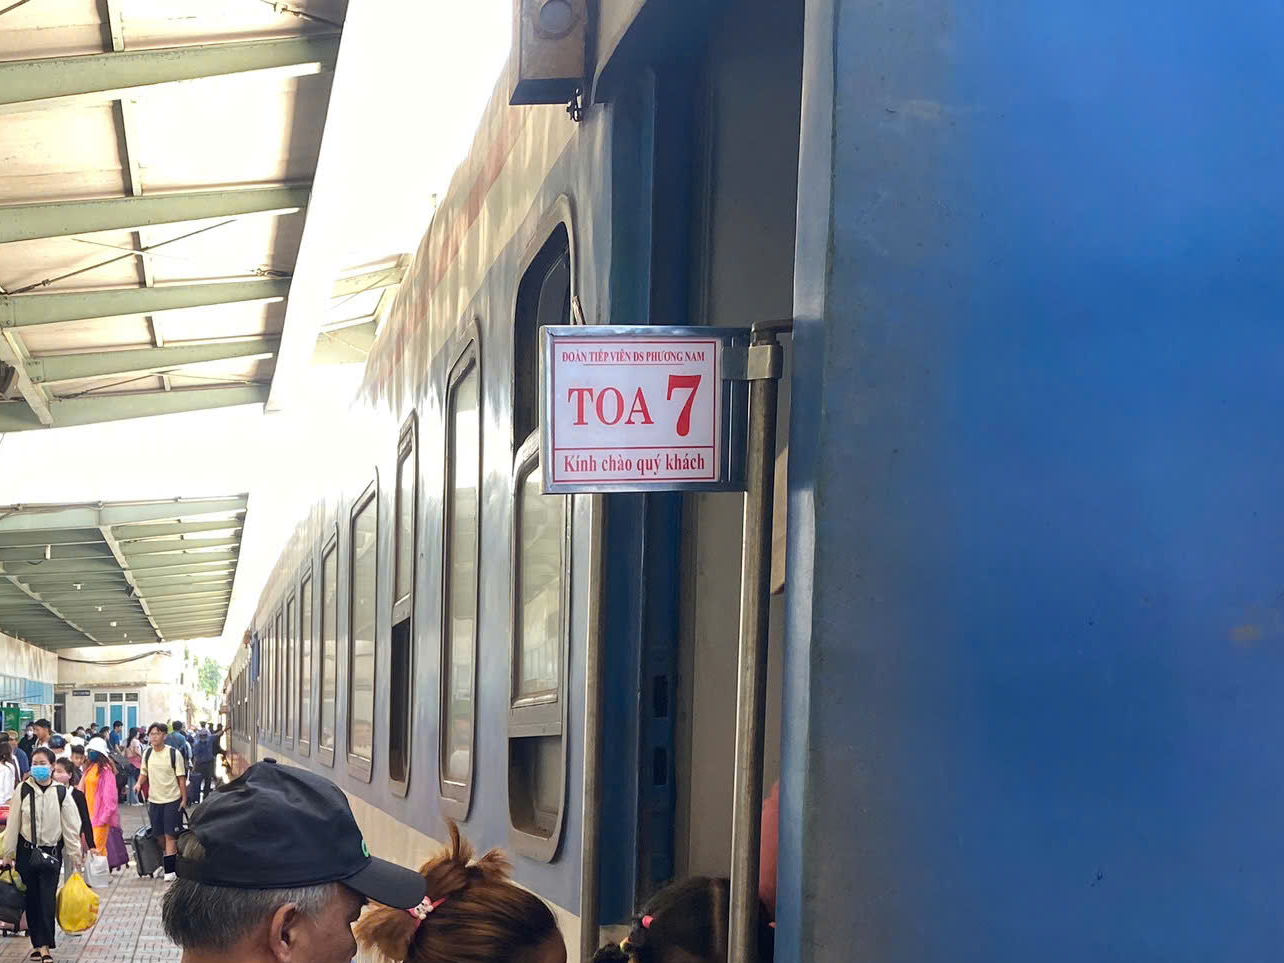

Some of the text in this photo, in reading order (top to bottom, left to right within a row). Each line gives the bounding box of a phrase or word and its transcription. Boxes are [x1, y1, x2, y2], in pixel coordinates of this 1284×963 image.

[685, 351, 705, 361] NAM
[568, 375, 702, 437] TOA 7
[564, 453, 705, 476] Kính chào quý khách
